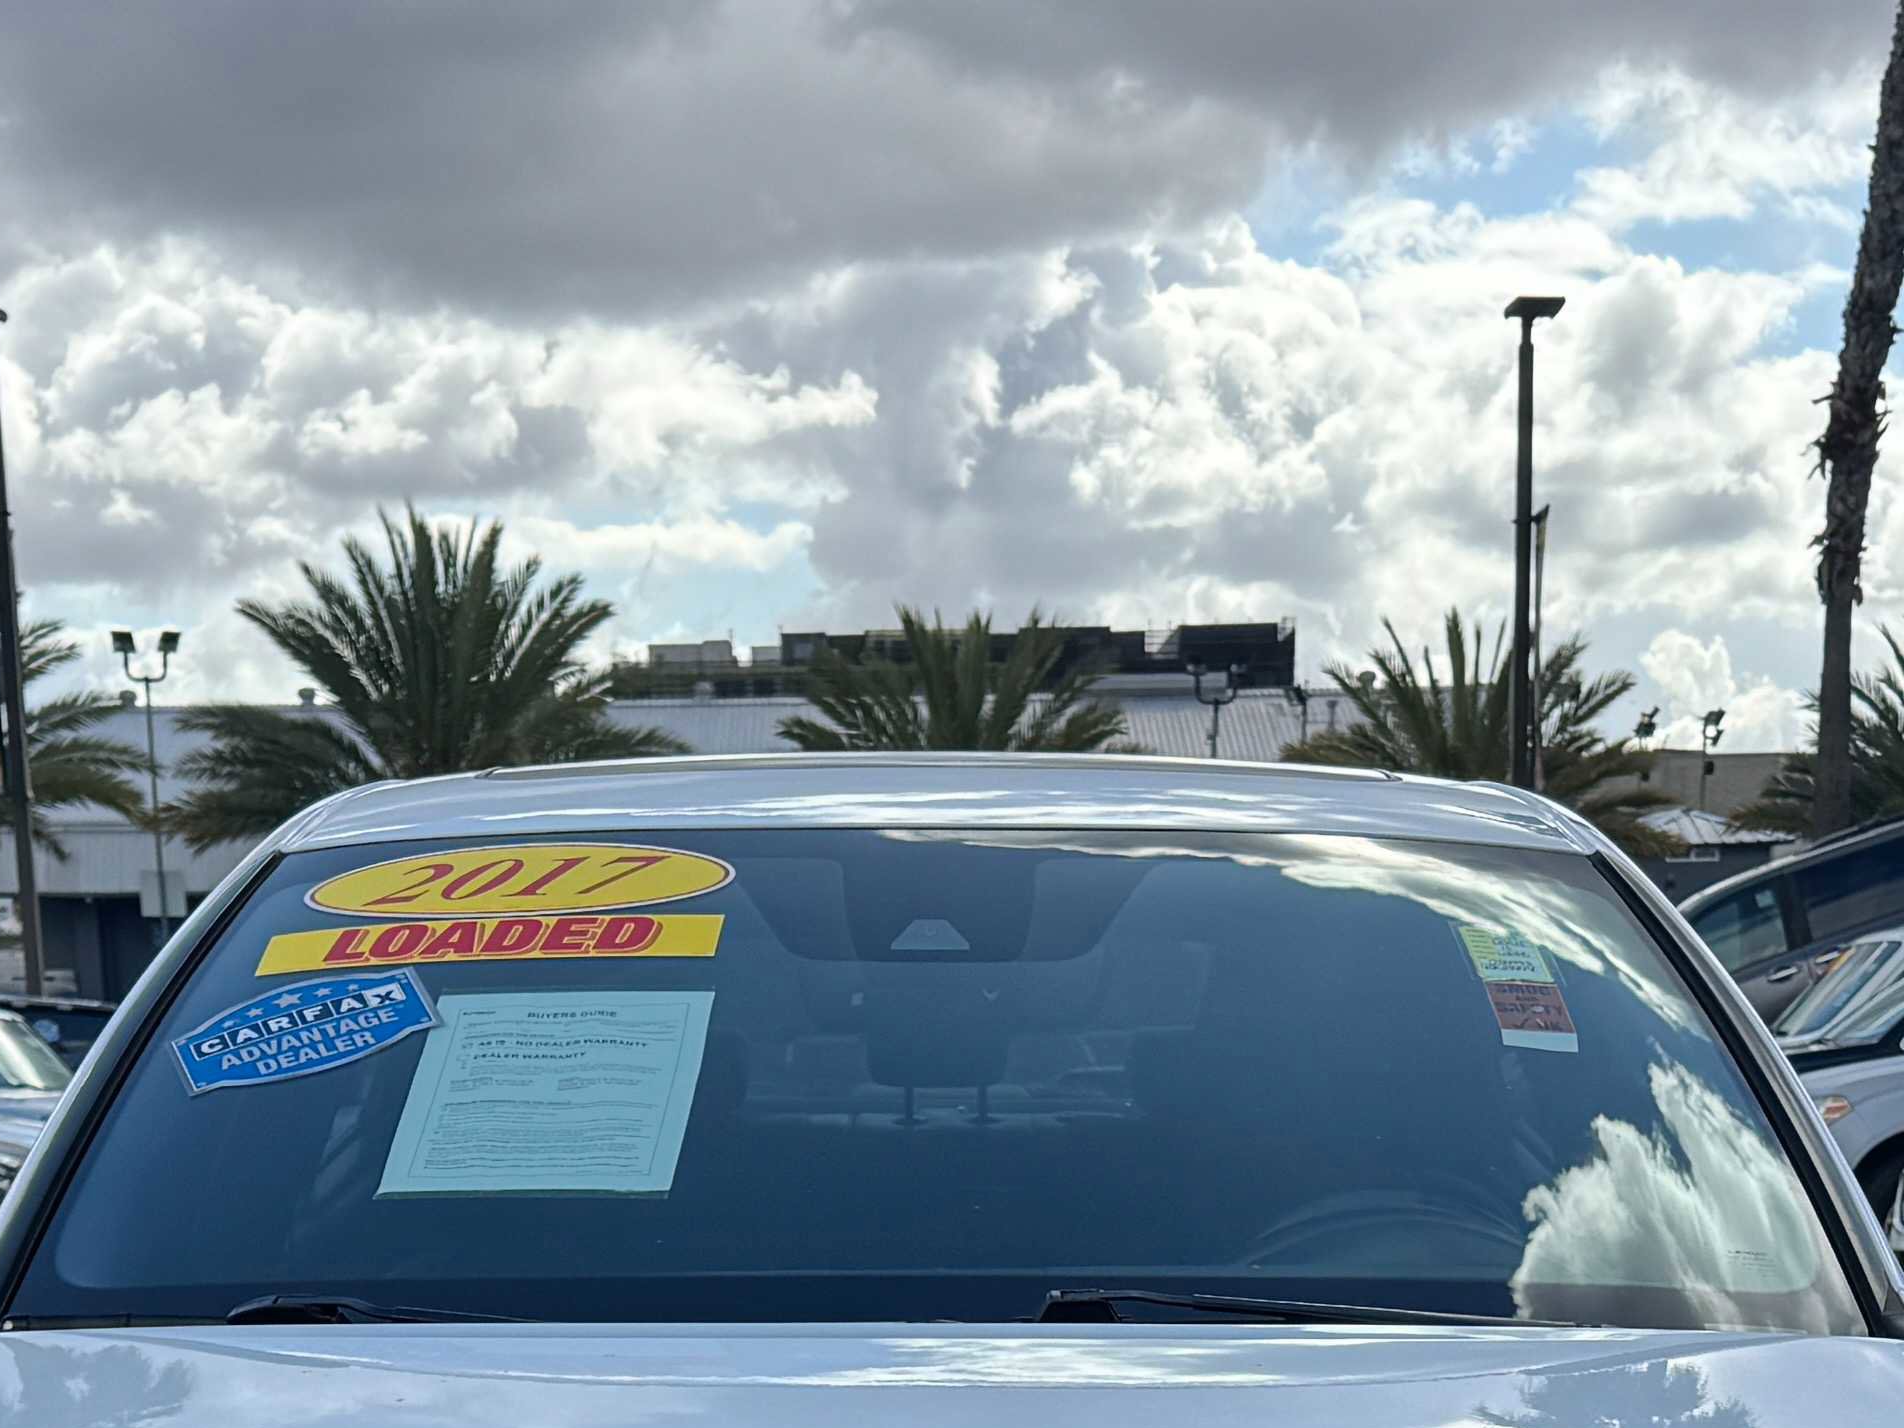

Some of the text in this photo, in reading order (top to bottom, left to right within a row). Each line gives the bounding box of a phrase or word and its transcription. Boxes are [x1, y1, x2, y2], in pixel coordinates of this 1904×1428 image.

[363, 856, 672, 906] 2017
[322, 915, 664, 965] LOADED
[197, 987, 400, 1057] CARFAX
[221, 1008, 399, 1071] ADVANTAGE
[255, 1031, 377, 1075] DEALER
